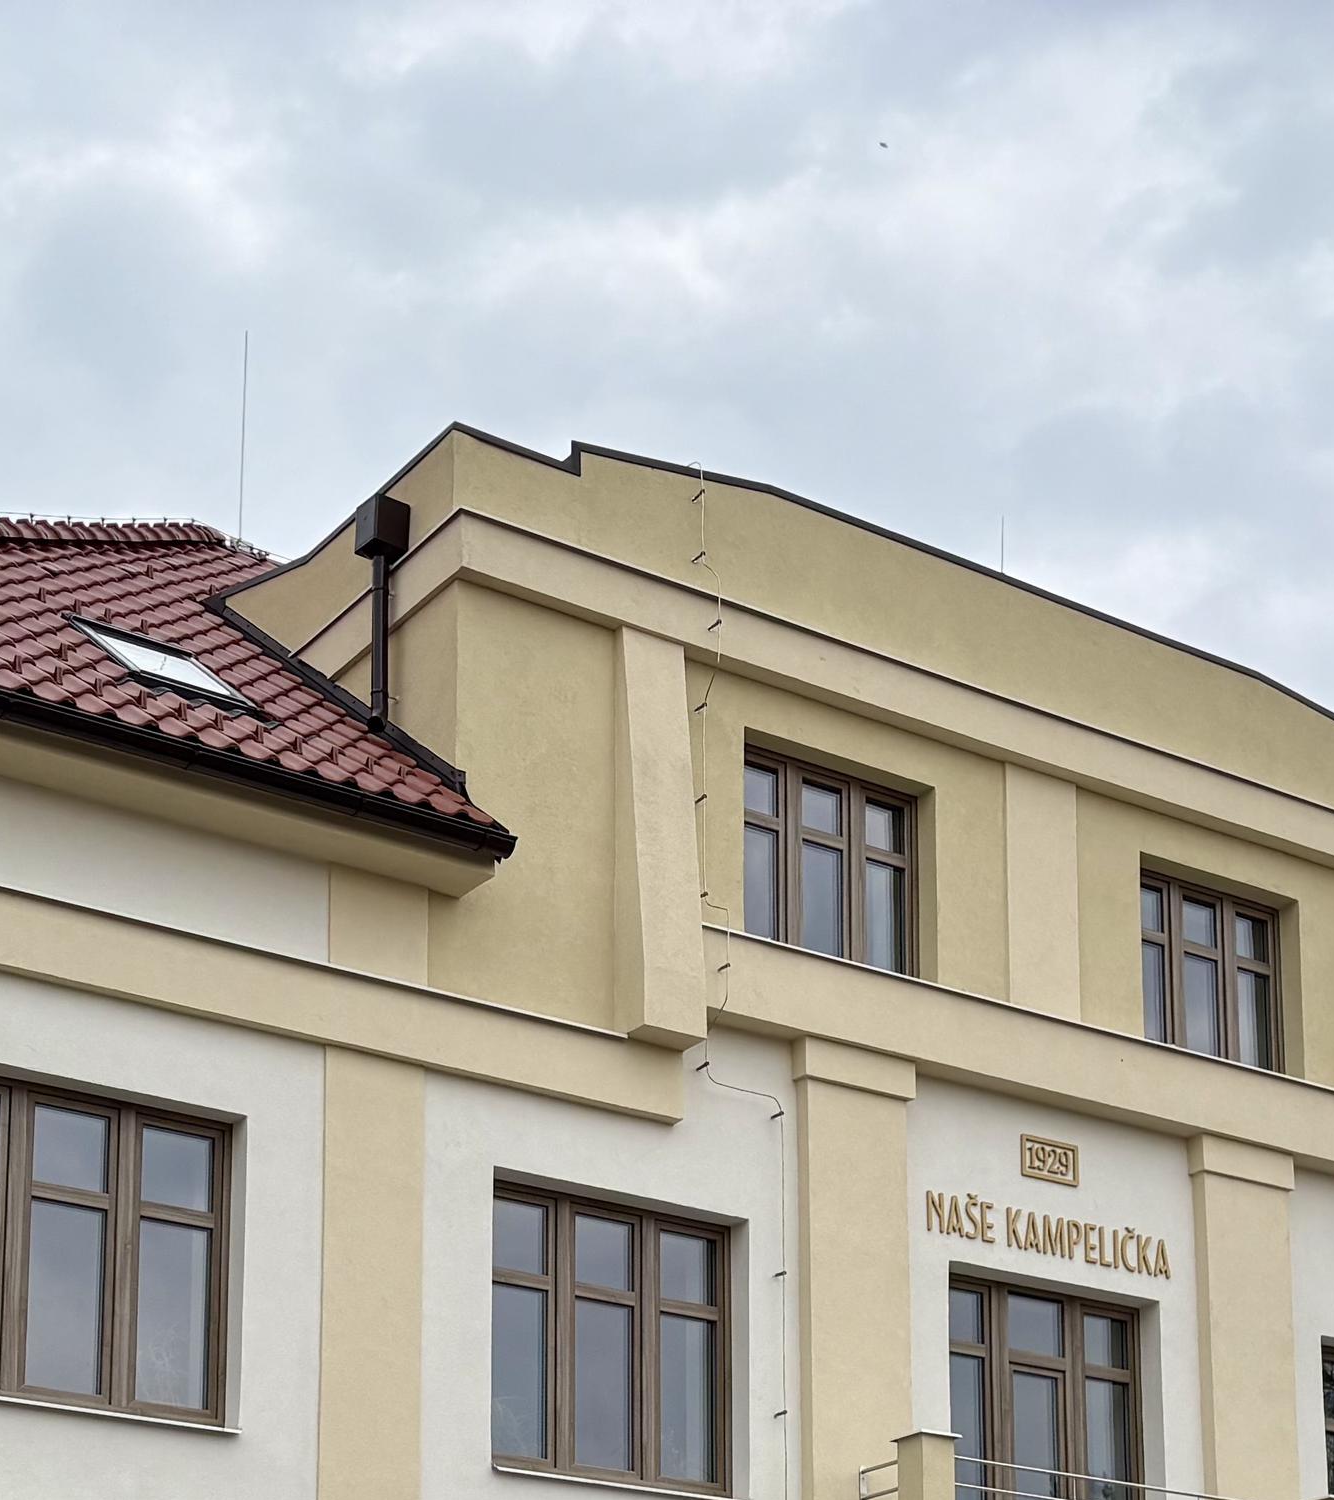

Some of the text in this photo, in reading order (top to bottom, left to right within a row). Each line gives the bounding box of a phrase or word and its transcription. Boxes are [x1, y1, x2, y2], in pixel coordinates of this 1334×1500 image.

[1026, 1143, 1071, 1176] 1929
[926, 1190, 1171, 1280] NAŠE KAMPELIČKA
